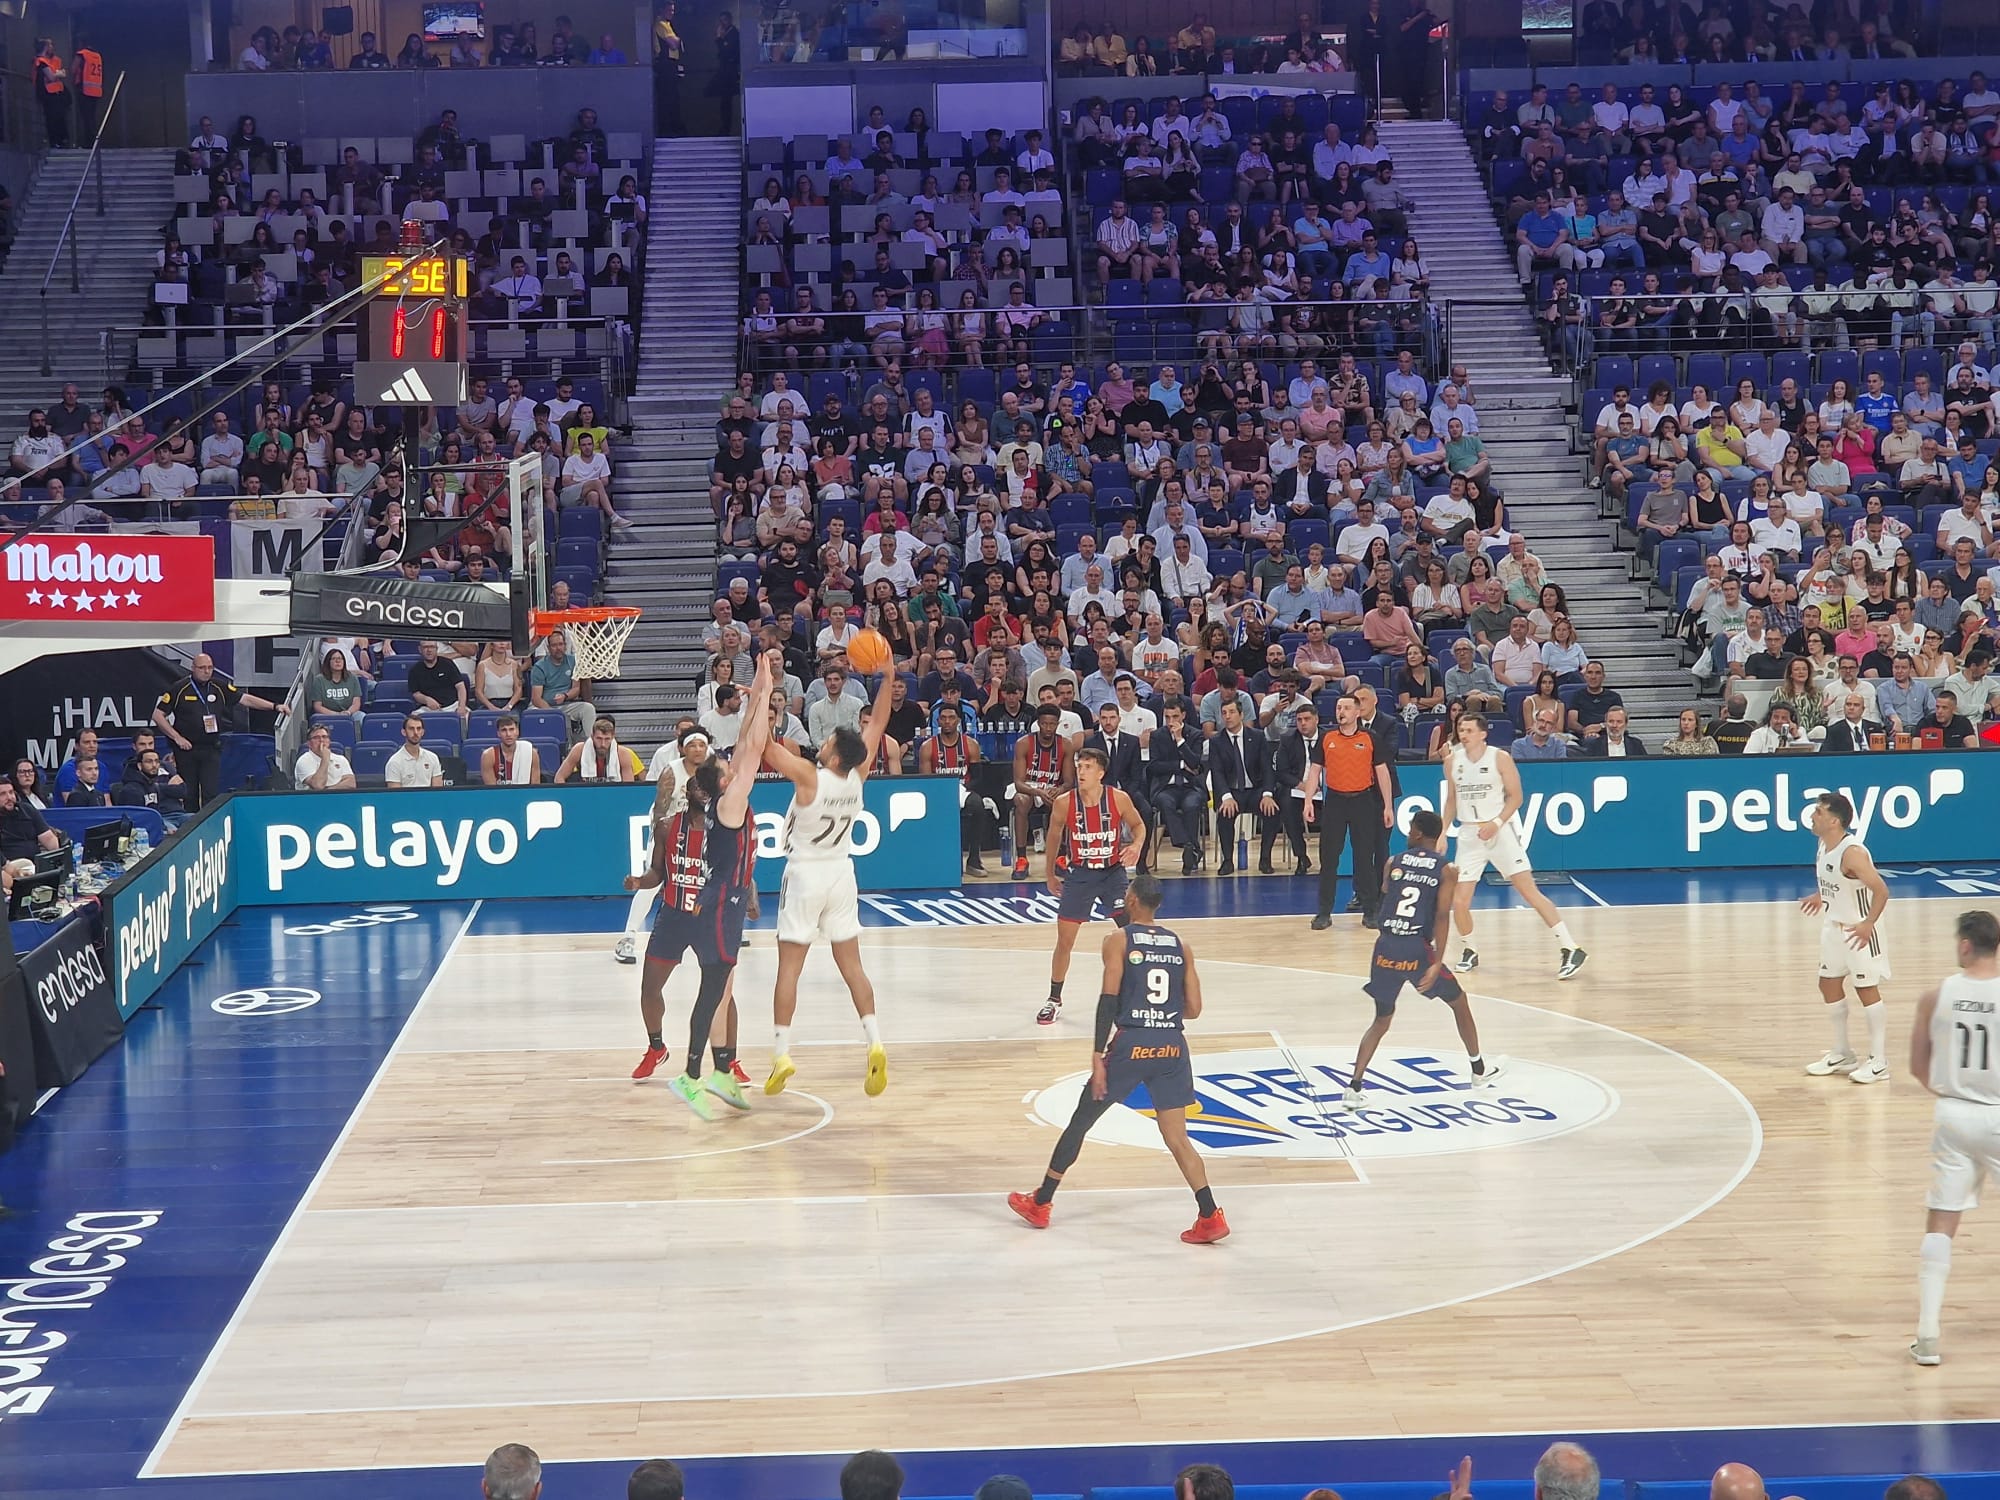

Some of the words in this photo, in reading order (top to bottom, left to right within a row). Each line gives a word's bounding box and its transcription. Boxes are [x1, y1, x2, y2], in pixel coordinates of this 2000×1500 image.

[4, 542, 164, 583] Mahou
[345, 597, 464, 628] endesa
[326, 686, 350, 698] SOHO
[1471, 805, 1478, 819] 1
[266, 805, 518, 891] pelayo
[1072, 828, 1117, 843] kingroyal
[1077, 846, 1114, 858] kosner
[184, 838, 227, 941] pelayo
[671, 873, 706, 885] kosne
[1402, 872, 1439, 888] AMUTIO
[684, 893, 696, 912] 5
[1395, 886, 1421, 918] 2
[120, 892, 170, 1007] pelayo
[1144, 953, 1183, 965] AMUTIO
[37, 943, 107, 1024] endesa
[1146, 968, 1170, 1005] 9
[1131, 1007, 1165, 1020] araba
[1130, 1044, 1181, 1060] Recalvi
[1955, 1022, 1989, 1071] 11
[1287, 1097, 1558, 1139] SEGUROS
